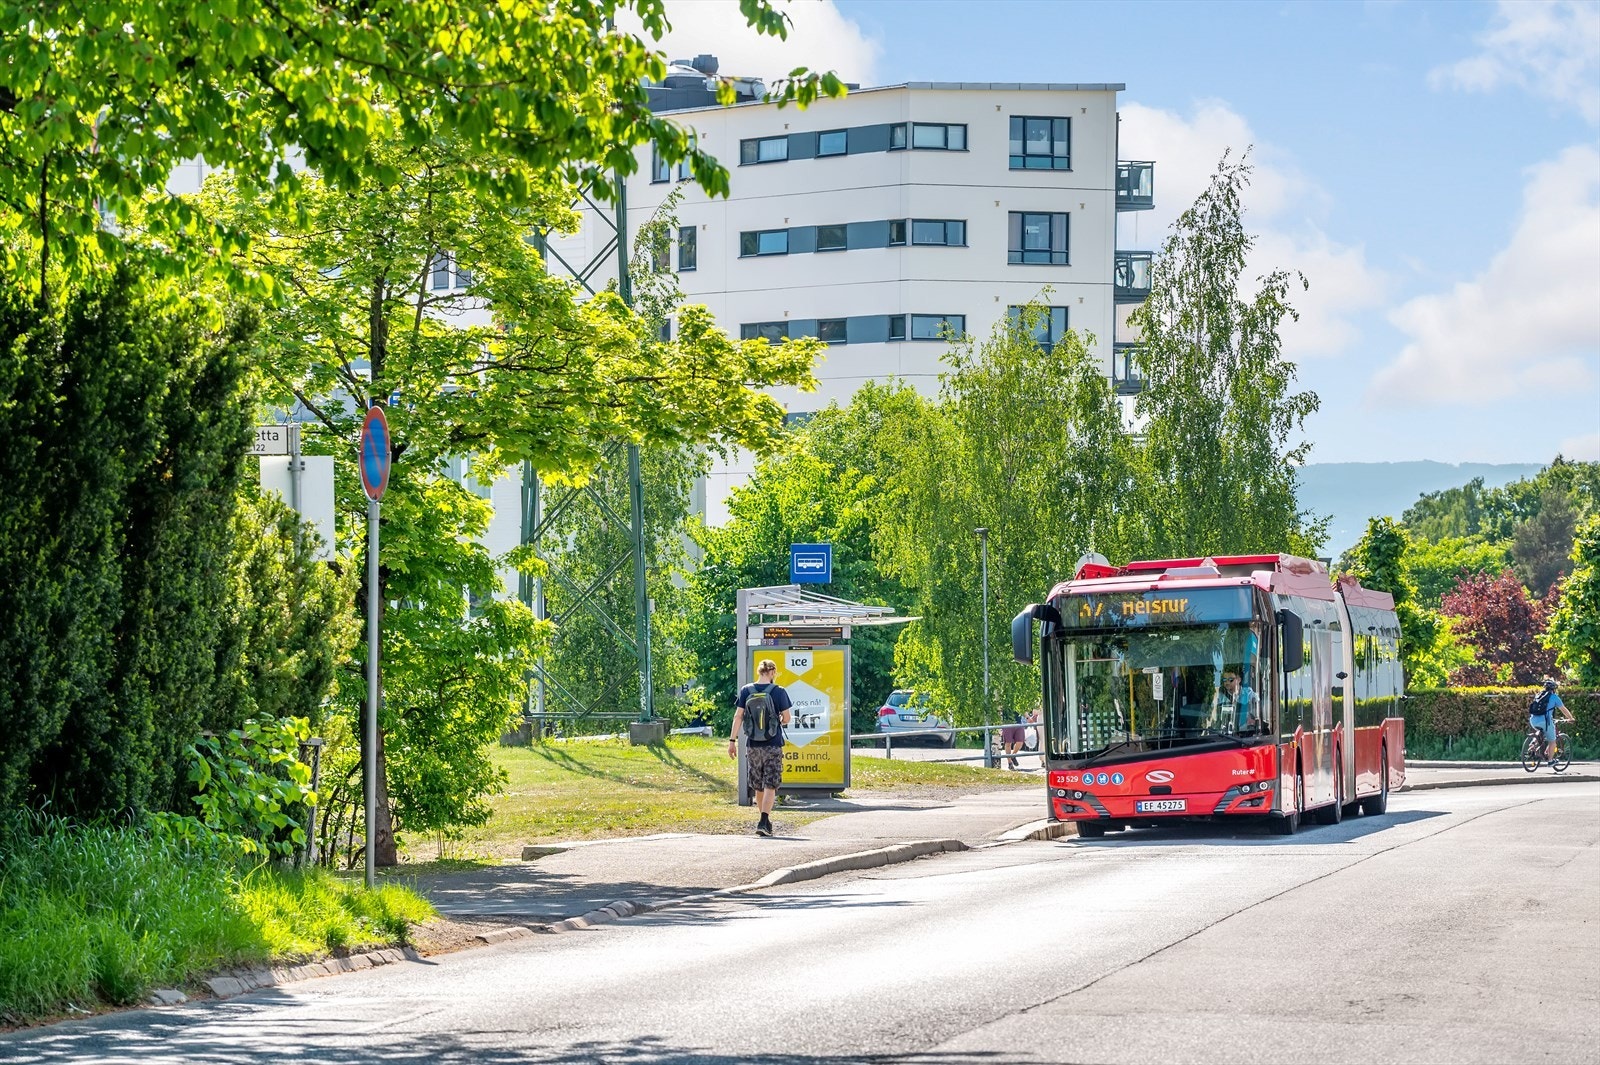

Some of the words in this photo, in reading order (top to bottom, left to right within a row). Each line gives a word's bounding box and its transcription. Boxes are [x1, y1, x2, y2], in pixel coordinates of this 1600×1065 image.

[791, 658, 808, 667] ice
[782, 752, 799, 760] GB
[801, 752, 804, 760] i
[786, 764, 793, 772] 2
[795, 764, 821, 772] mnd.
[1156, 801, 1183, 810] 45275
